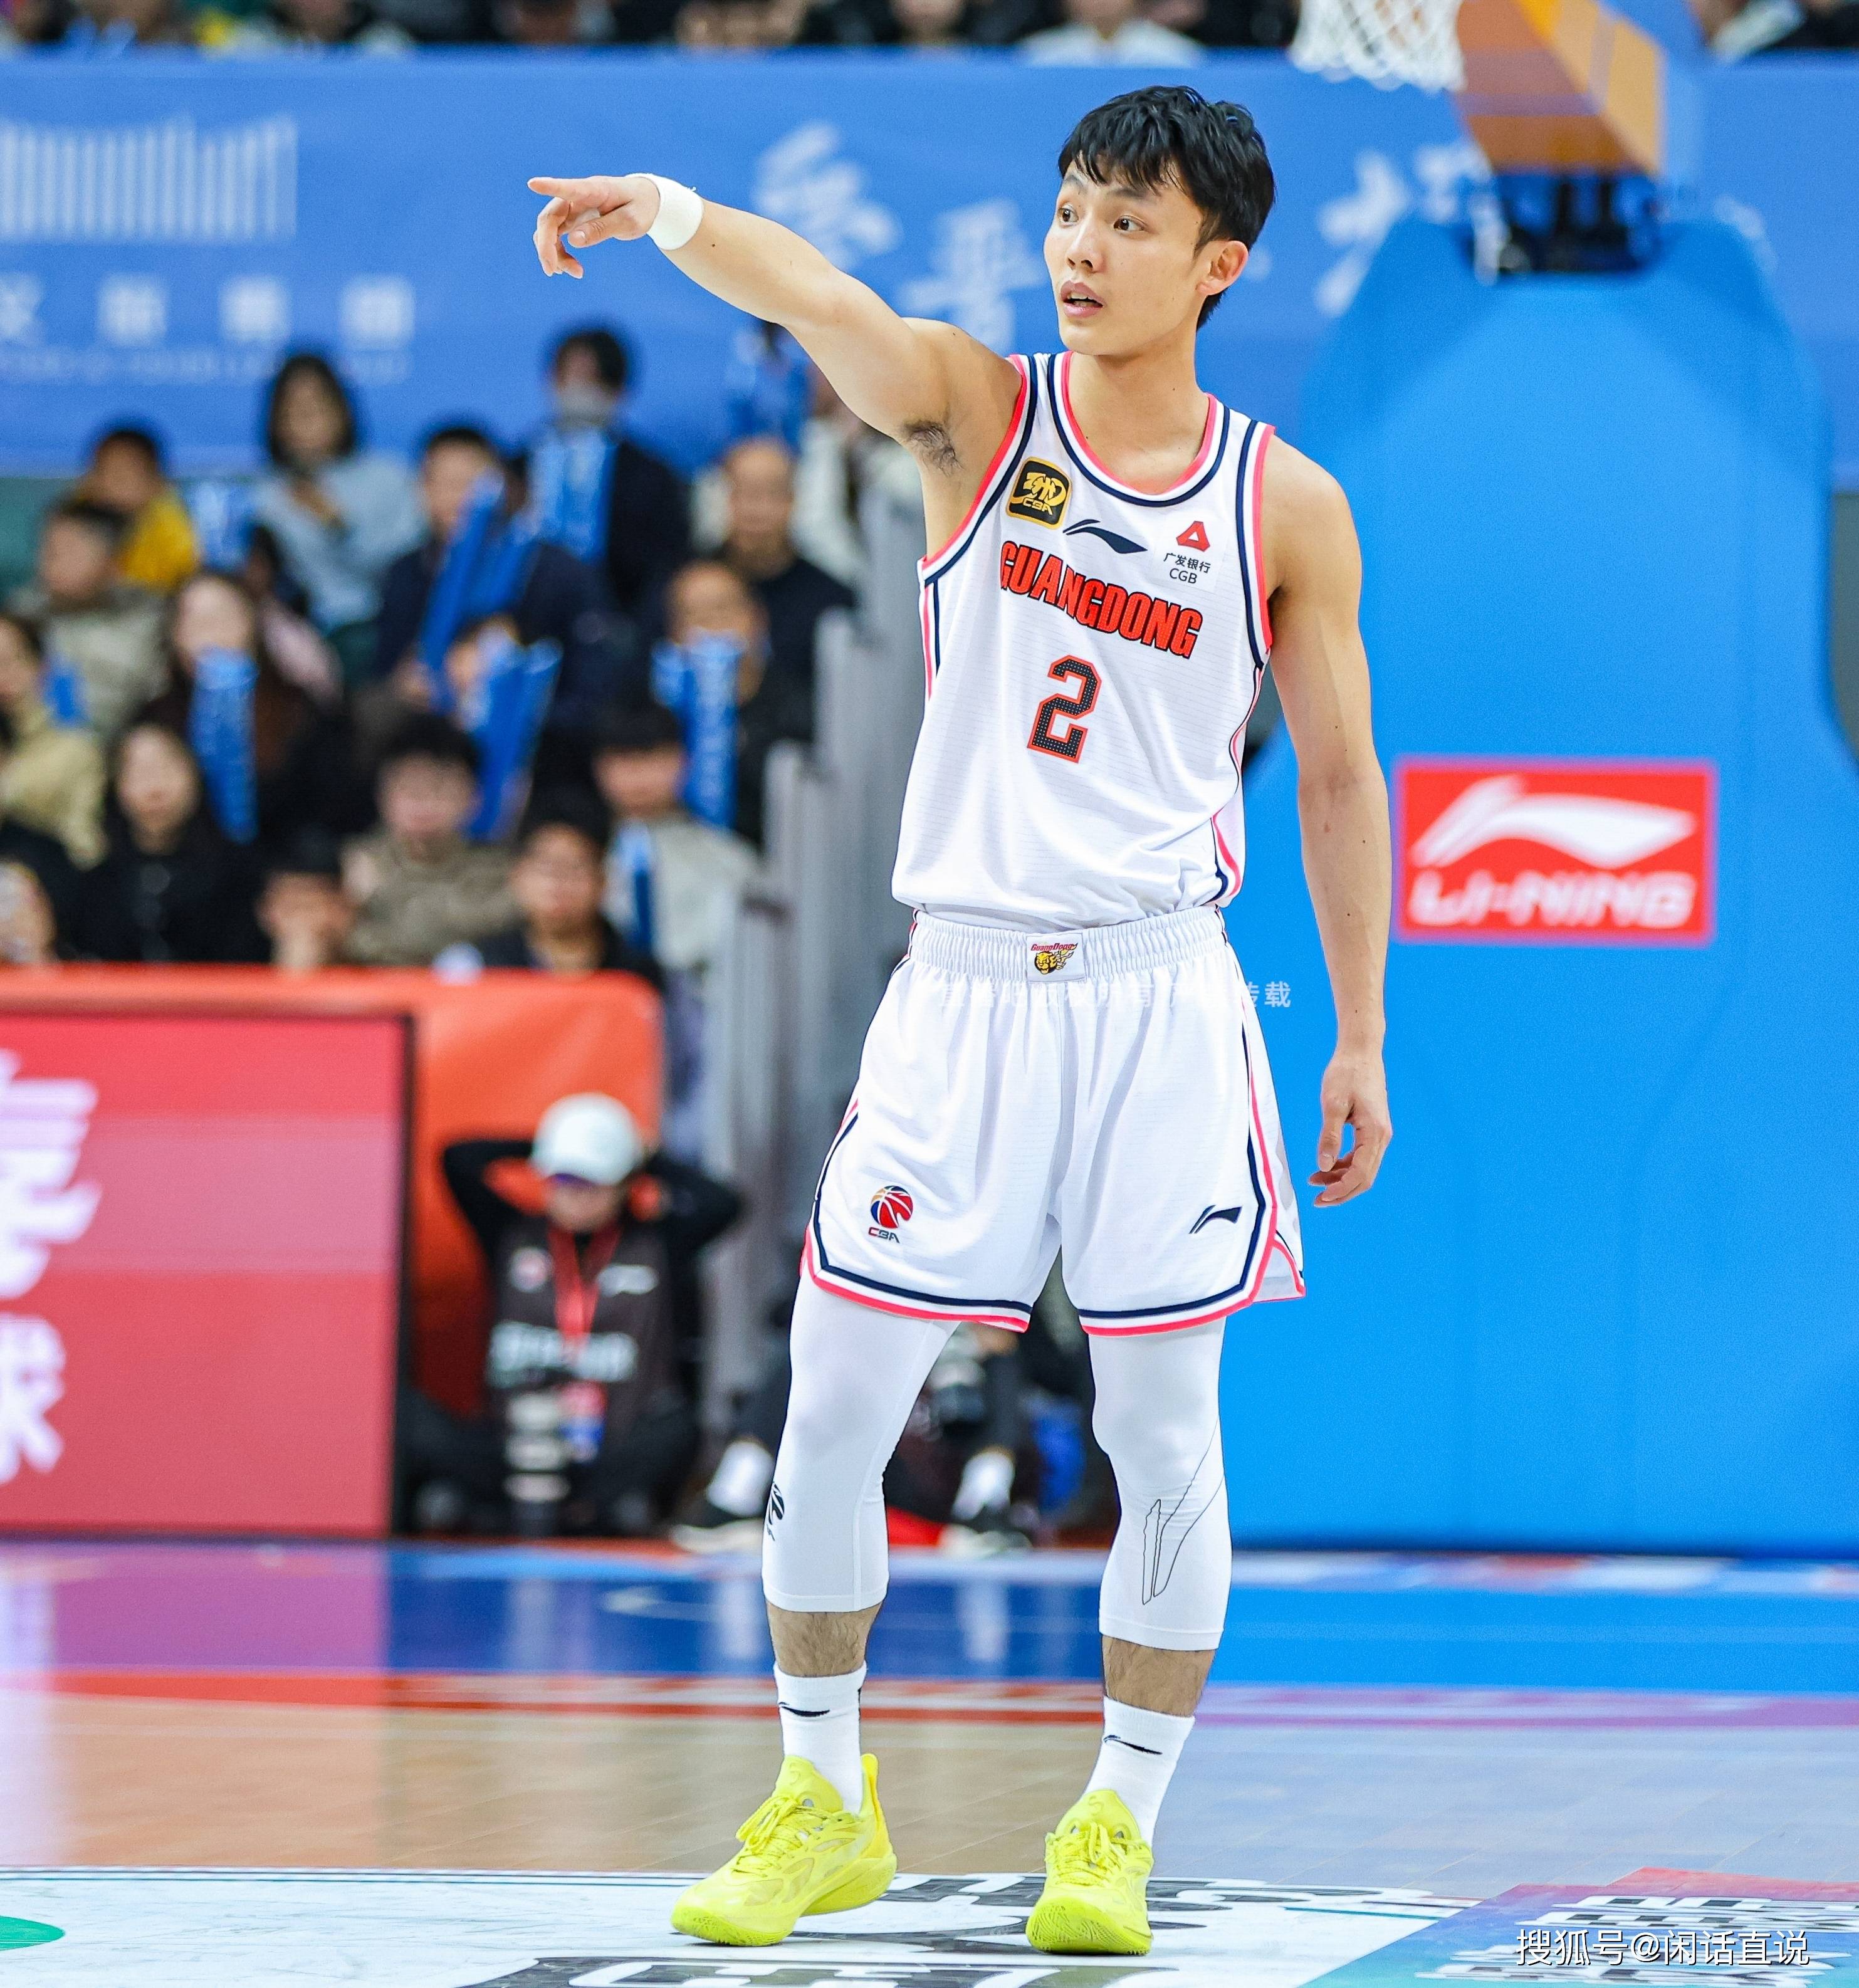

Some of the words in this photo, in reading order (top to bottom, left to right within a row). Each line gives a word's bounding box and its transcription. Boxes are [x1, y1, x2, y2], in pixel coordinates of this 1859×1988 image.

[1022, 496, 1053, 516] CBA
[1163, 553, 1212, 573] 广发银行
[1170, 568, 1198, 584] CGB
[1000, 540, 1203, 660] GUANGDONG
[1027, 654, 1102, 764] 2
[868, 1227, 900, 1243] CBA
